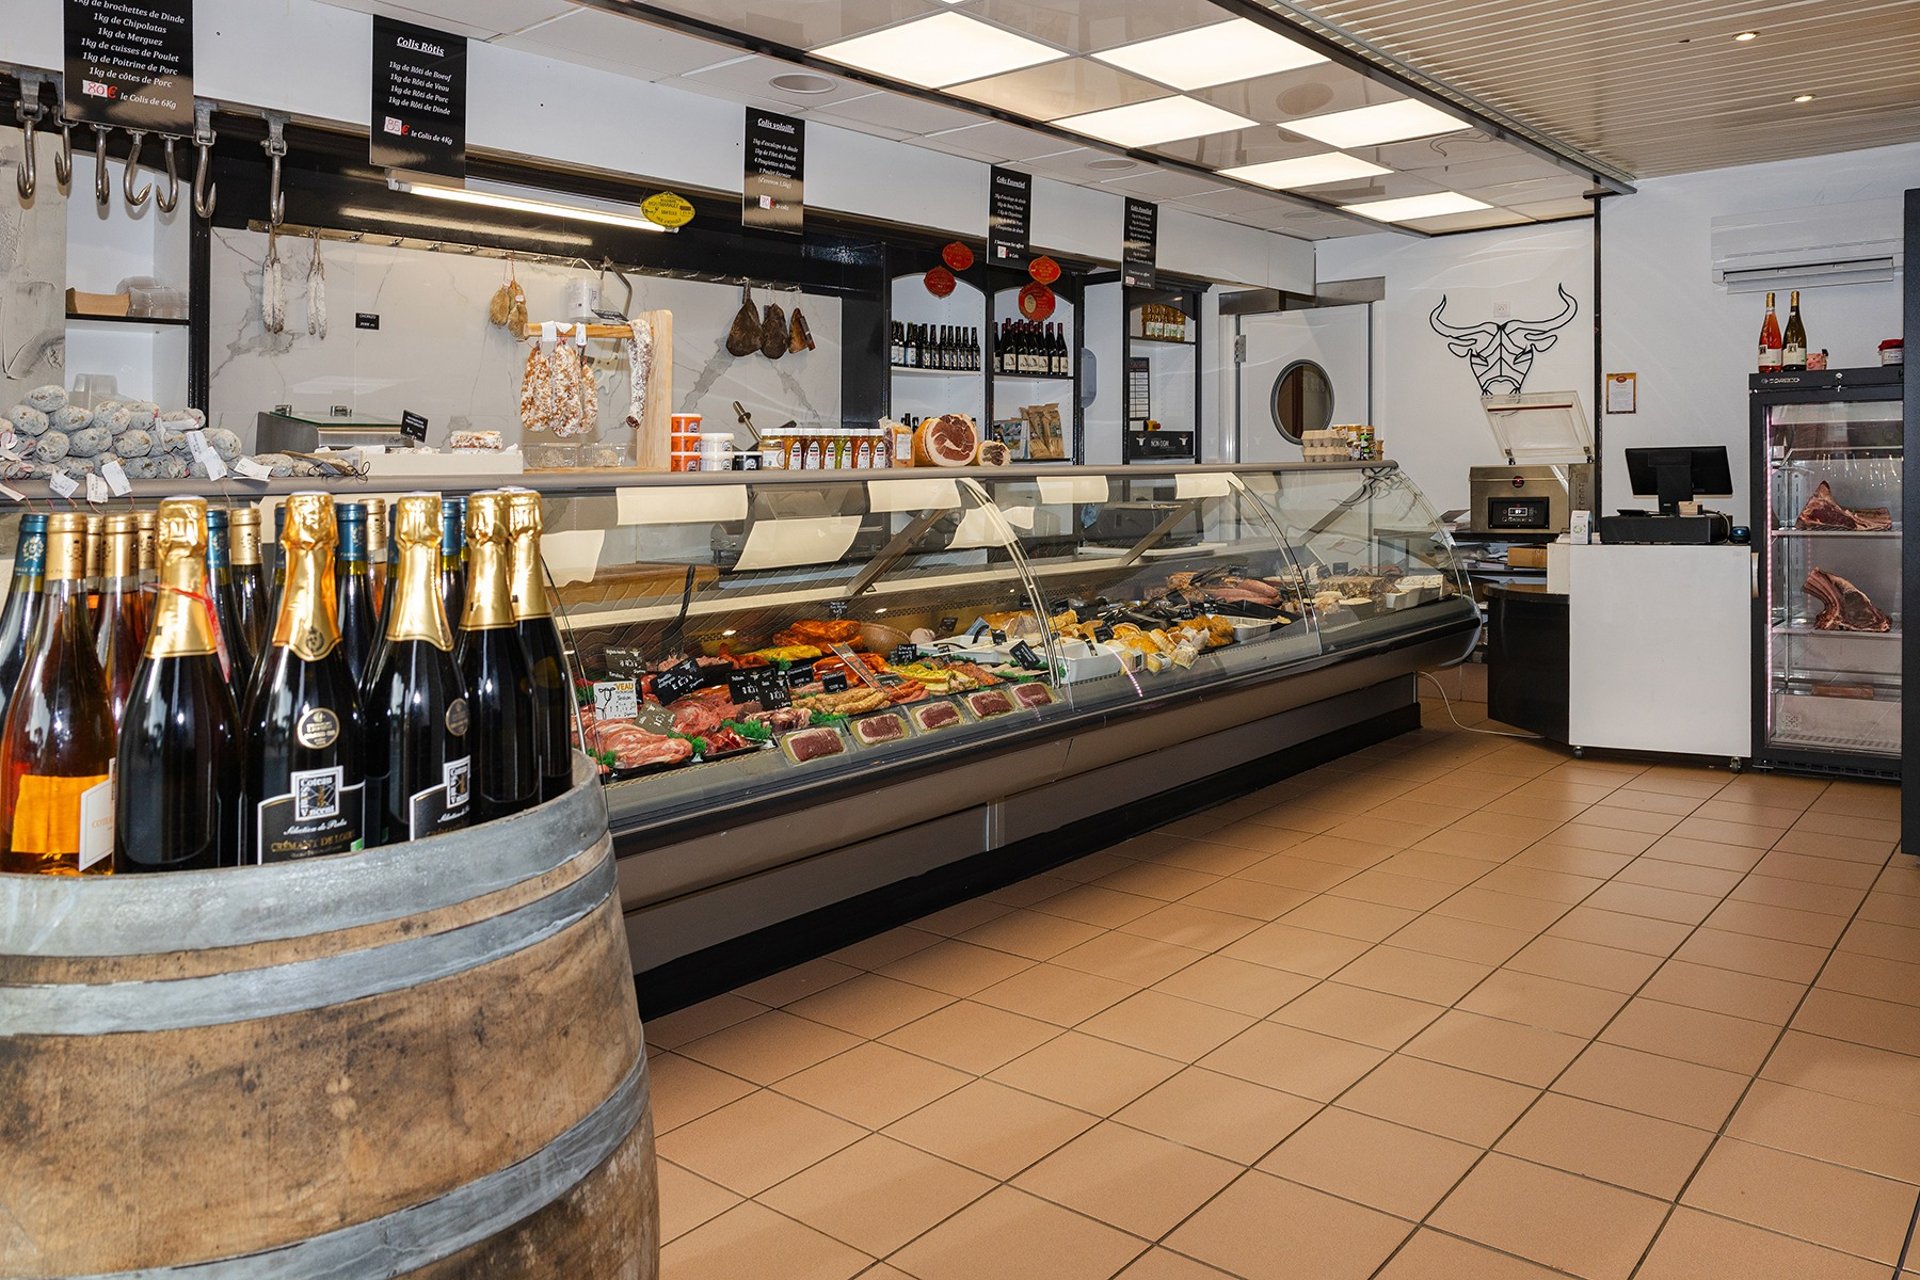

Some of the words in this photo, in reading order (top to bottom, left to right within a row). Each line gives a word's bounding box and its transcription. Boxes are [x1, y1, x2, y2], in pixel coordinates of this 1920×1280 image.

[104, 1, 148, 16] brochettes
[149, 10, 159, 18] de
[160, 12, 185, 24] Dinde
[94, 13, 109, 24] 1kg
[111, 16, 121, 24] de
[123, 18, 167, 34] Chipolatas
[98, 27, 113, 38] 1kg
[115, 31, 125, 39] de
[127, 32, 163, 46] Merguez
[81, 38, 97, 49] 1kg
[98, 41, 109, 50] de
[110, 45, 140, 55] cuisses
[141, 49, 152, 58] de
[153, 51, 179, 62] Poulet
[396, 36, 420, 50] Colis
[421, 42, 445, 57] Rôtis
[82, 52, 98, 63] 1kg
[100, 55, 111, 63] de
[112, 57, 146, 70] Poitrine
[147, 64, 158, 72] de
[159, 66, 178, 76] Porc
[389, 61, 401, 71] 1kg
[411, 66, 424, 74] Rôti
[433, 70, 452, 82] Boeuf
[89, 67, 105, 78] 1kg
[118, 71, 140, 82] côtes
[153, 78, 172, 88] Porc
[390, 73, 402, 82] 1kg
[412, 78, 425, 86] Rôti
[434, 82, 449, 92] Veau
[130, 94, 148, 104] Colis
[150, 97, 160, 106] de
[161, 99, 177, 110] 6Kg
[391, 85, 402, 94] 1kg
[412, 90, 425, 99] Rôti
[435, 94, 448, 103] Porc
[389, 96, 400, 106] 1kg
[410, 101, 423, 109] Rôti
[433, 105, 451, 115] Dinde
[418, 131, 432, 140] Colis
[757, 118, 772, 128] Colis
[773, 122, 795, 134] volaille
[615, 683, 634, 692] VEAU
[301, 777, 333, 787] Coteau
